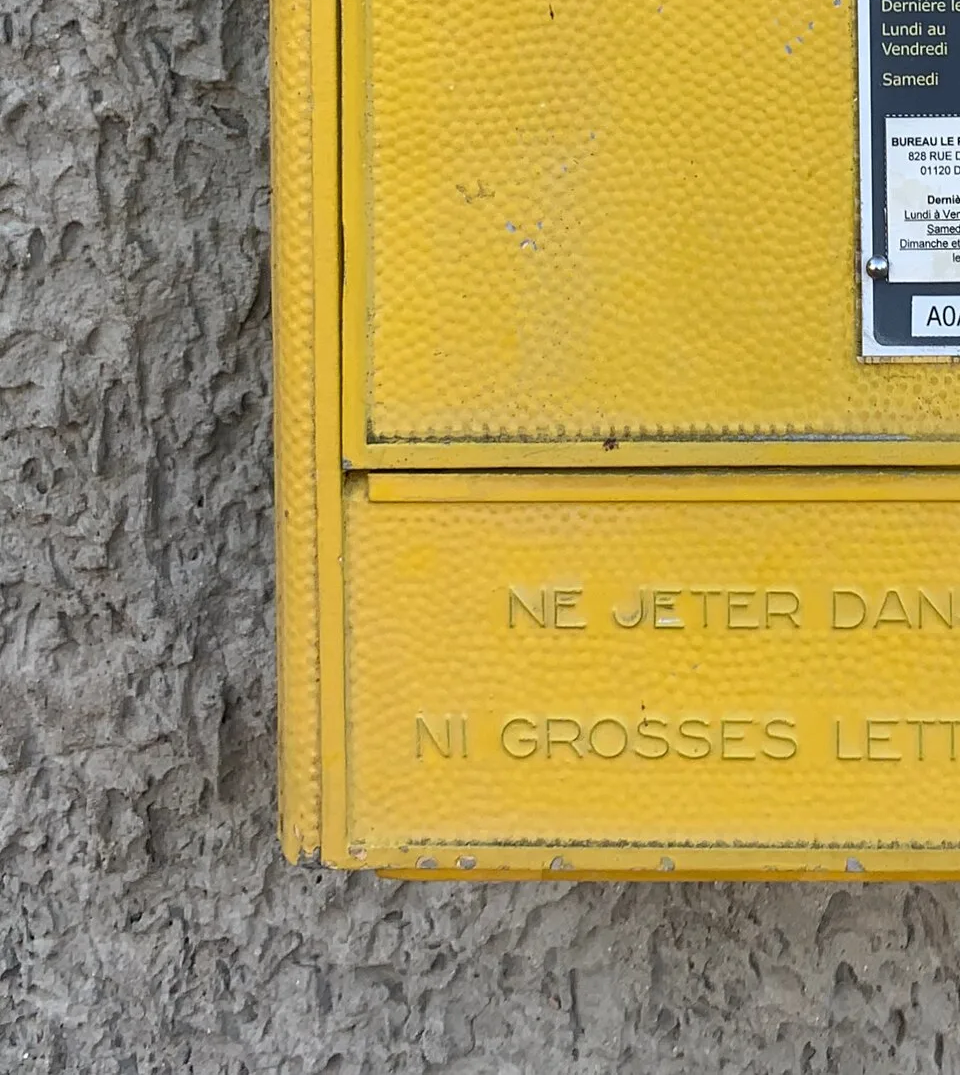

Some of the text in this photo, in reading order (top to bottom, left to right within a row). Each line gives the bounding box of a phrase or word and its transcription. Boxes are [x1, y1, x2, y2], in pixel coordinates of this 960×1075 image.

[882, 22, 946, 36] Lundi au
[882, 42, 948, 56] Vendredi
[882, 72, 938, 86] Samedi
[891, 137, 938, 148] BUREAU
[940, 137, 954, 147] LE
[908, 151, 927, 162] 828
[930, 151, 952, 161] RUE
[920, 165, 951, 176] 01120
[904, 210, 931, 221] Lundi
[934, 210, 941, 220] à
[900, 239, 949, 249] Dimanche
[952, 239, 960, 249] et
[508, 587, 588, 630] NE
[612, 587, 802, 631] JETER
[415, 715, 468, 759] NI
[500, 717, 798, 761] GROSSES
